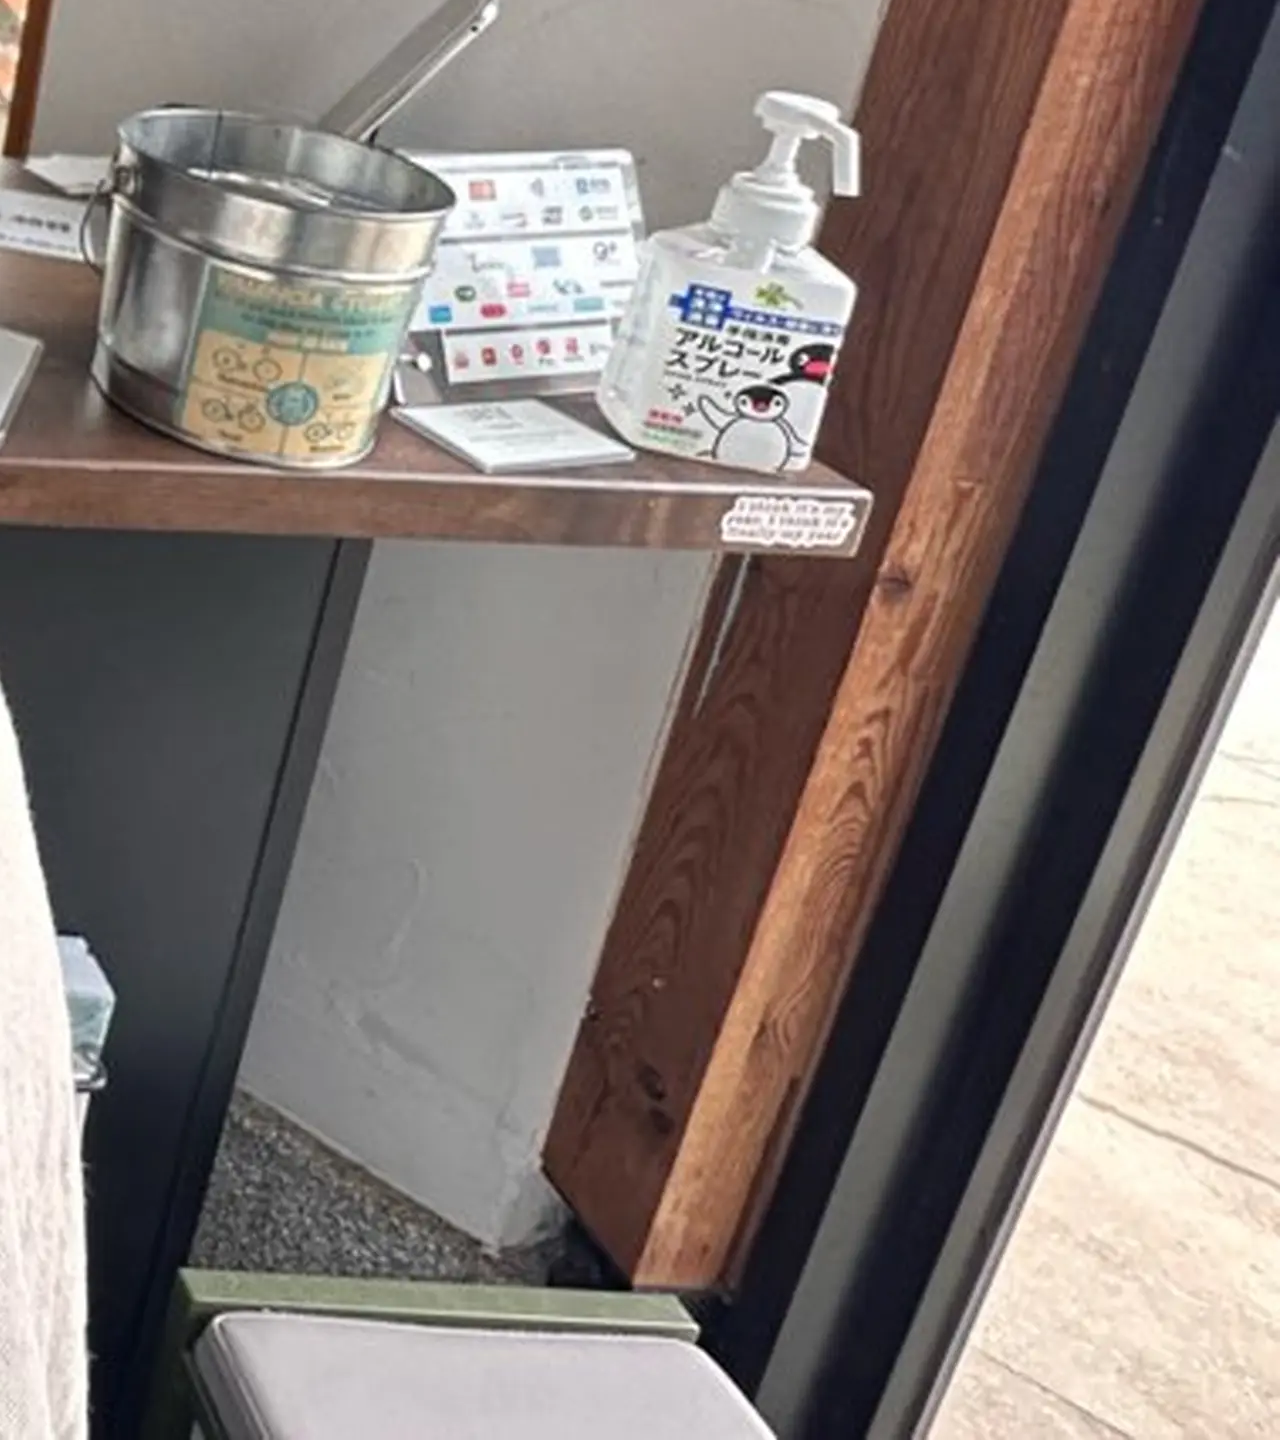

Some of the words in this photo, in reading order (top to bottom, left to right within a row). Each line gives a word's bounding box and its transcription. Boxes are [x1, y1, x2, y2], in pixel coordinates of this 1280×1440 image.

[674, 327, 785, 365] アルコール
[665, 349, 763, 380] スプレー
